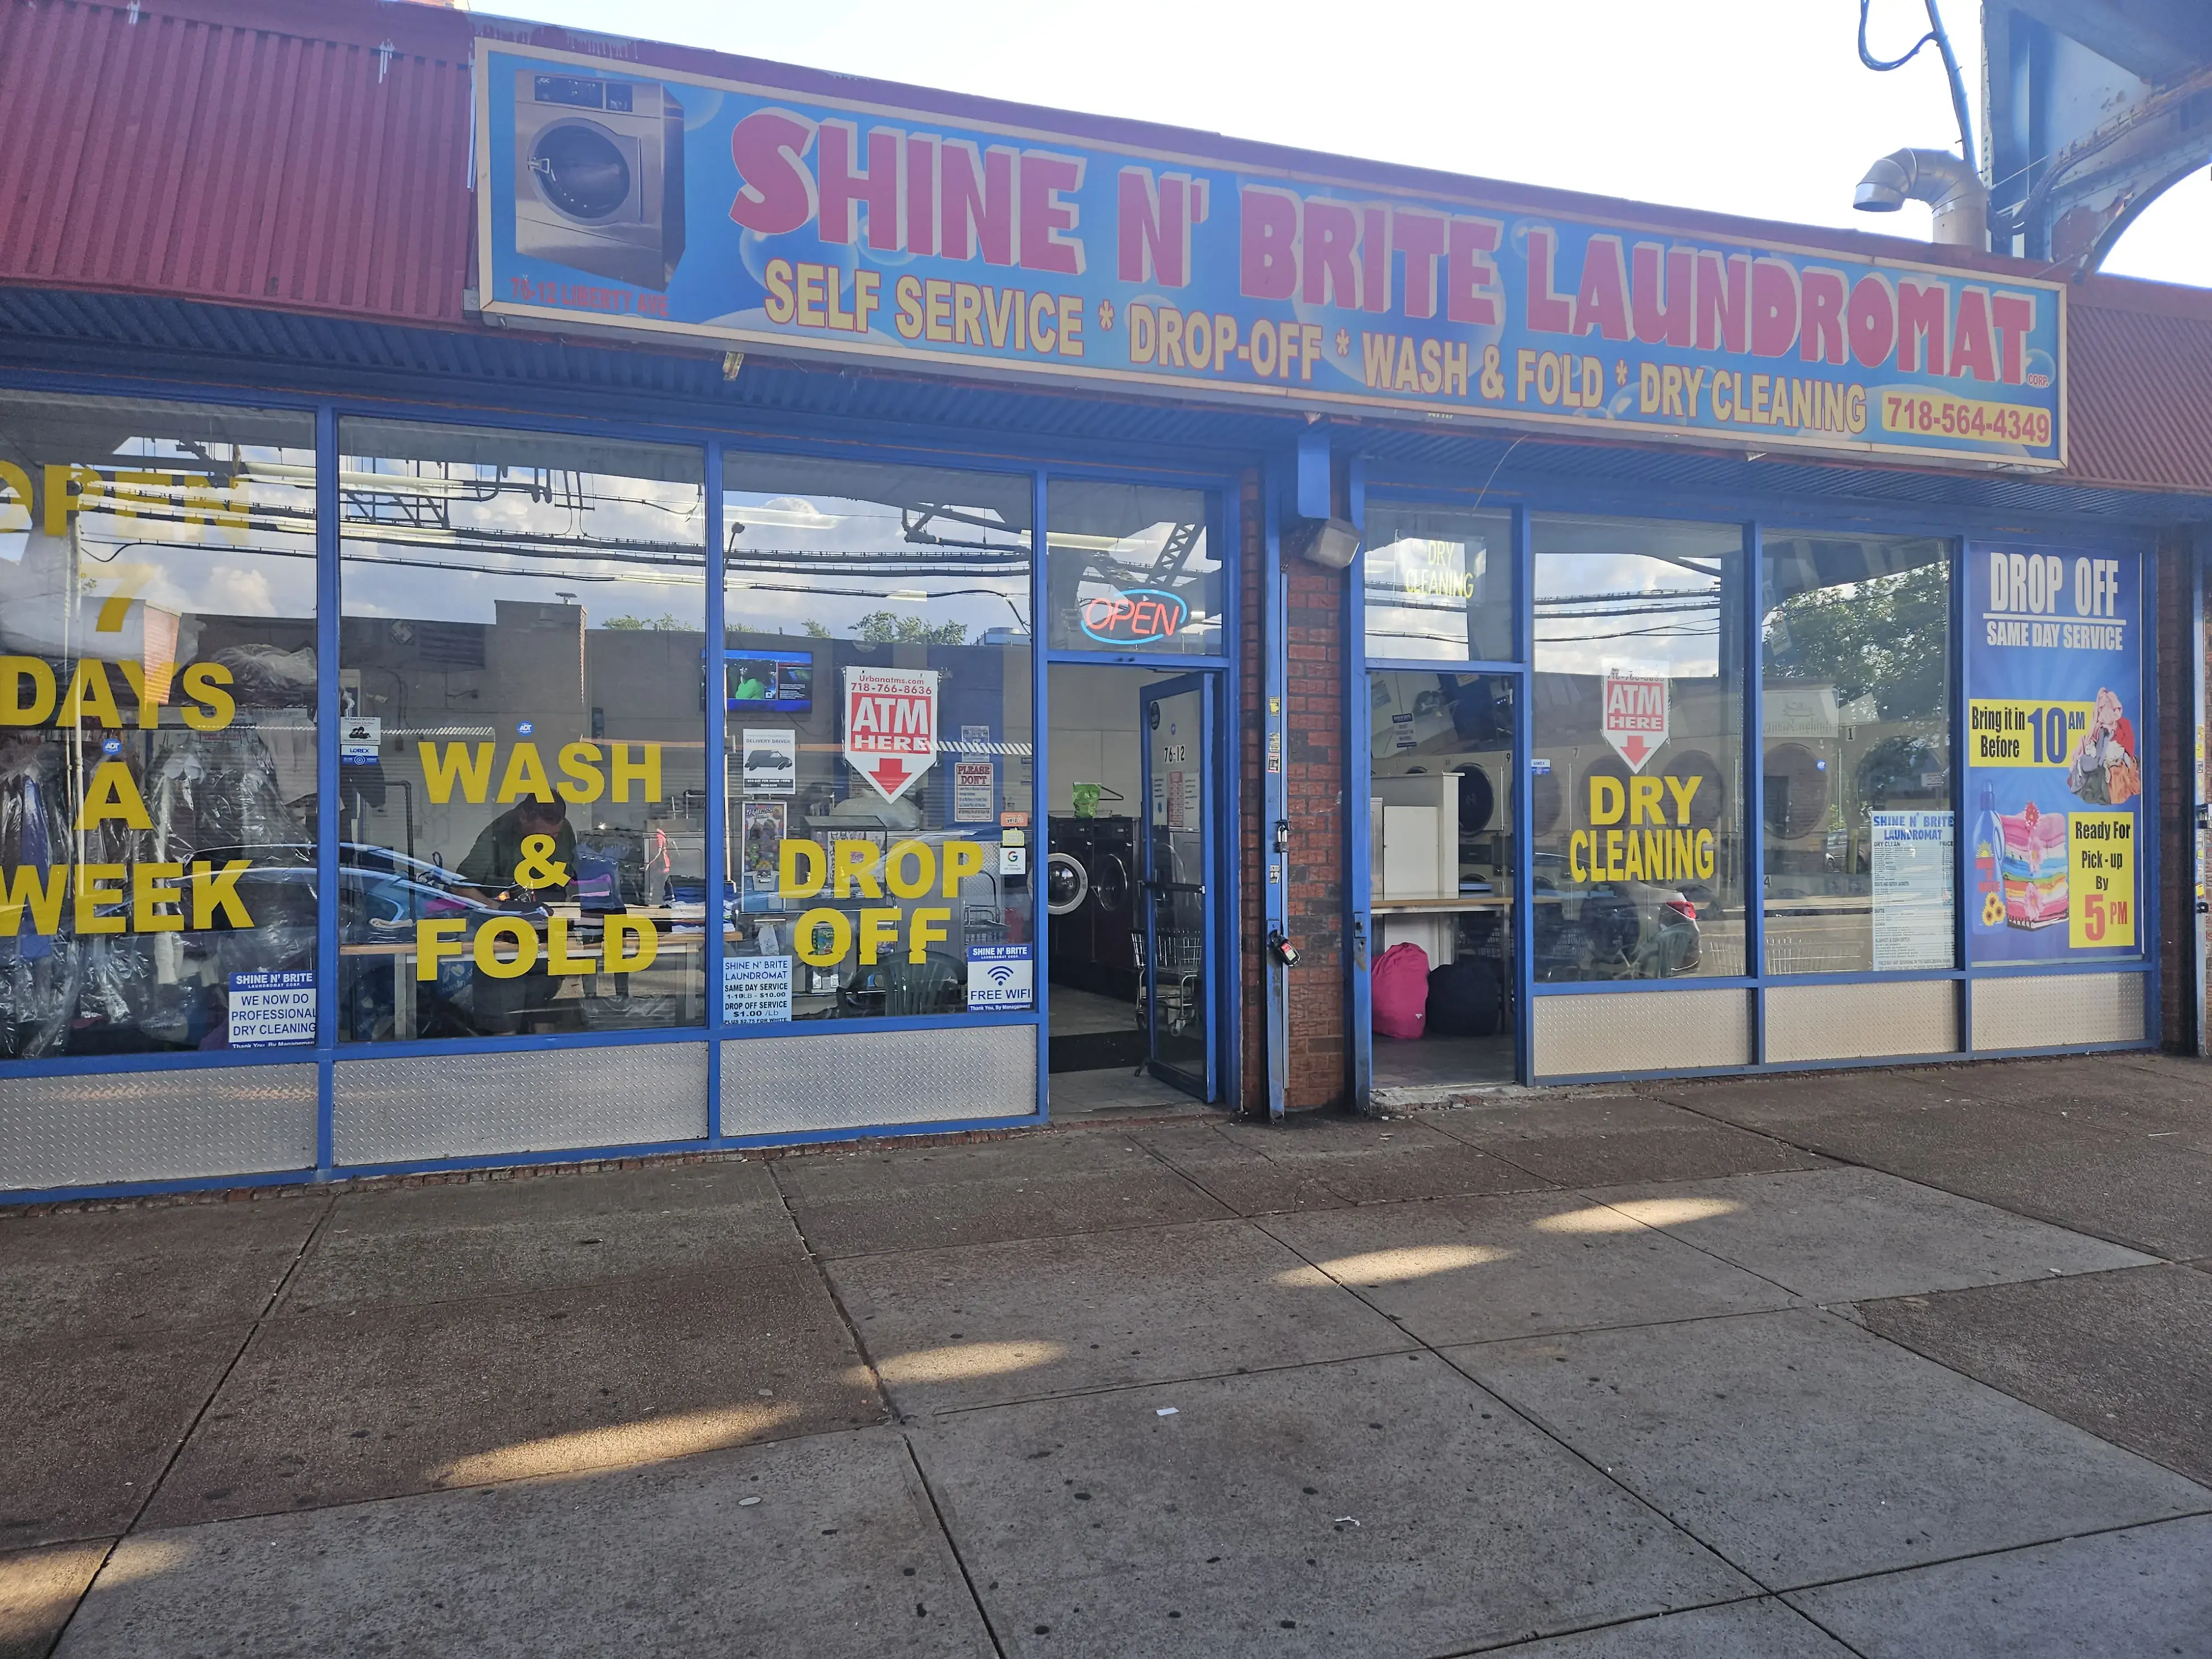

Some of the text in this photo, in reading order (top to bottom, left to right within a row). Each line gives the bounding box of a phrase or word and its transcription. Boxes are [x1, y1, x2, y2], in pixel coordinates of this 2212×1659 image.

[729, 107, 2036, 386] SHINE N' BRITE LAUNDROMAT
[510, 277, 670, 317] 76-12 LIBERTY AVE
[764, 258, 1867, 434] SELF SERVICE DROP-OFF WASH & FOLD DRY CLEANING
[2028, 372, 2049, 388] CORP.
[1887, 397, 2050, 444] 718-564-4349
[1428, 540, 1455, 567] DRY
[1405, 568, 1474, 599] CLEANING
[1990, 552, 2119, 617] DROP OFF
[1086, 597, 1180, 636] OPEN
[1987, 620, 2123, 651] SAME DAY SERVICE
[851, 682, 932, 695] 718-766-8636
[859, 675, 924, 685] Urbanatms.com
[0, 656, 236, 731] DAYS
[1608, 684, 1662, 715] ATM
[852, 697, 929, 734] ATM
[1610, 716, 1662, 729] HERE
[1971, 705, 2026, 732] Bring it in
[2068, 711, 2085, 730] AM
[854, 734, 928, 751] HERE
[1980, 734, 2020, 758] Before
[2027, 707, 2067, 764] 10
[1164, 745, 1185, 763] 76-12
[1506, 753, 1511, 763] 9
[418, 742, 661, 804] WASH
[957, 765, 990, 775] PLEASE
[961, 775, 987, 784] DON'T
[74, 761, 153, 830] A
[1590, 776, 1703, 826] DRY
[1874, 812, 1954, 827] SHINE N' BRITE
[1885, 830, 1943, 841] LAUNDROMAT
[2075, 821, 2131, 844] Ready For
[514, 834, 571, 889] &
[1569, 828, 1714, 883] CLEANING
[2081, 849, 2102, 869] Pick
[2110, 852, 2123, 870] up
[779, 839, 984, 899] DROP
[2095, 875, 2109, 891] By
[0, 860, 255, 937] WEEK
[2084, 894, 2127, 942] 5 PM
[416, 915, 659, 981] FOLD
[794, 907, 951, 967] OFF
[973, 947, 995, 956] SHINE
[1006, 947, 1027, 955] BRITE
[725, 961, 788, 970] SHINE N' BRITE
[725, 971, 787, 980] LAUNDROMAT
[236, 973, 313, 984] SHINE N' BRITE
[242, 993, 309, 1005] WE NOW DO
[759, 1000, 787, 1009] SERVICE
[971, 989, 1030, 1000] FREE WIFI
[232, 1008, 316, 1021] PROFESSIONAL
[233, 1022, 316, 1036] DRY CLEANING
